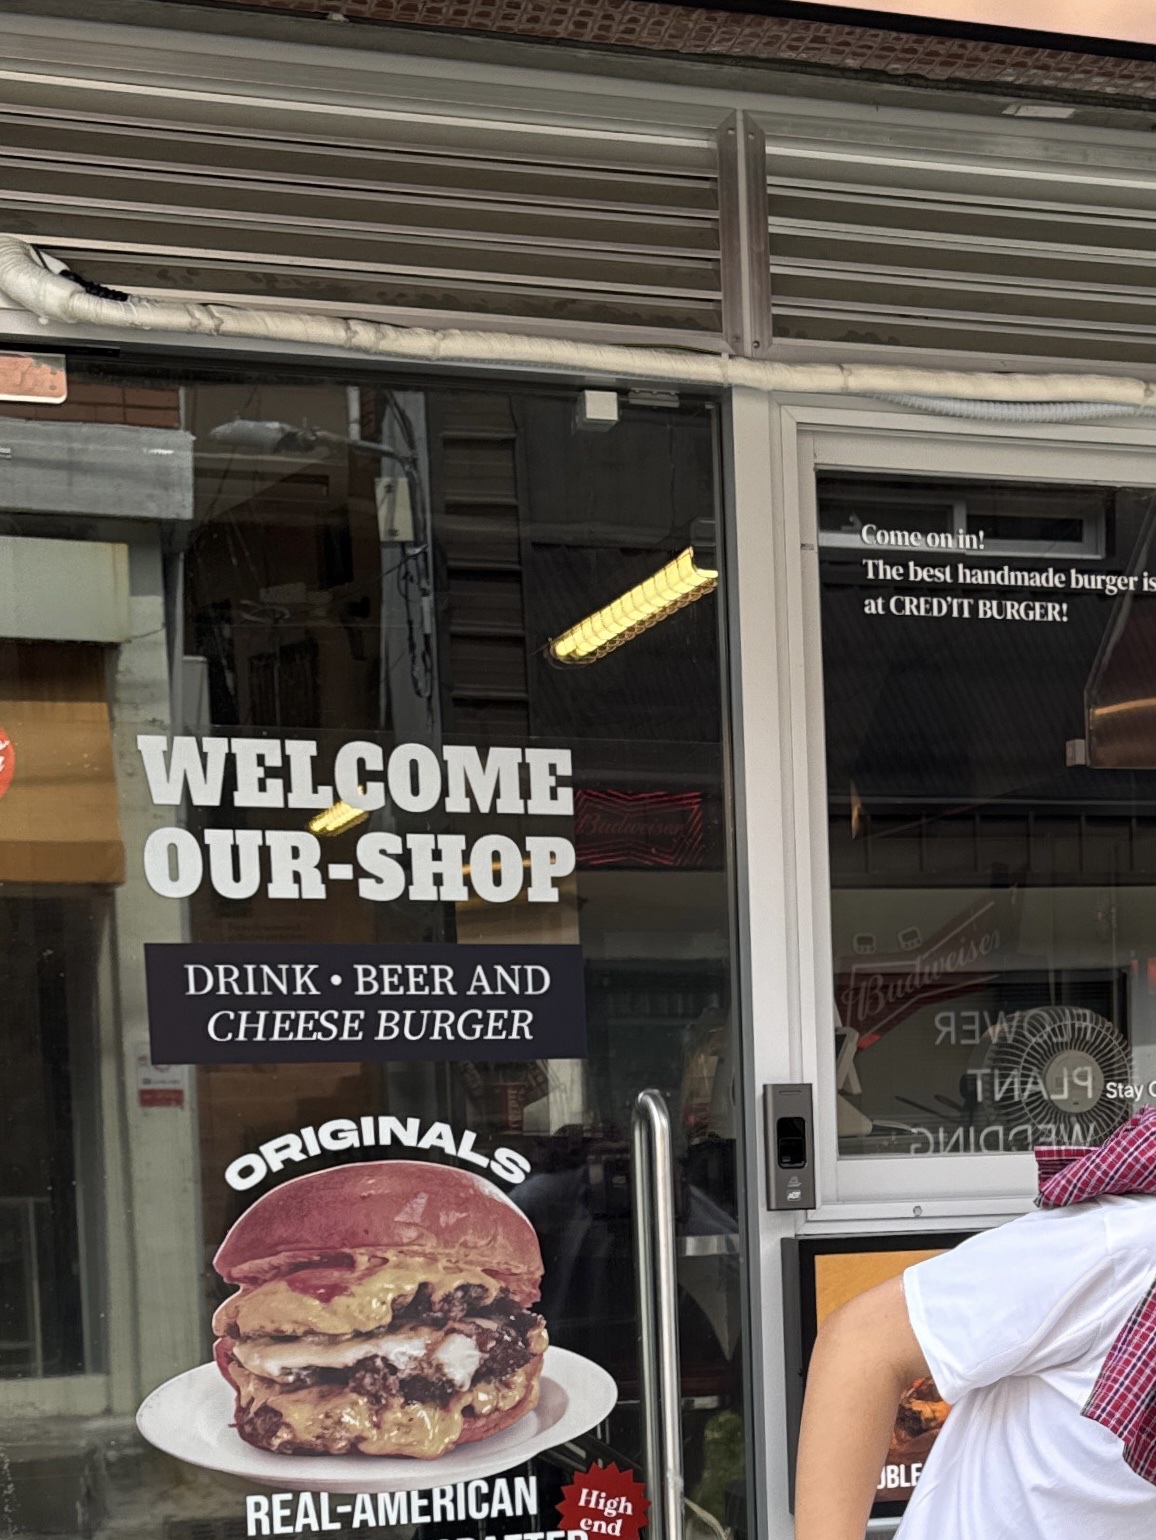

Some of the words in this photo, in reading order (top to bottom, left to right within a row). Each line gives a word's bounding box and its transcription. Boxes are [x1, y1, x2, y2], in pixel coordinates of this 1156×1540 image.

[861, 523, 922, 549] Come
[926, 532, 953, 551] on
[957, 529, 985, 551] in!
[862, 559, 904, 581] The
[908, 560, 953, 583] best
[957, 562, 1066, 588] handmade
[1070, 568, 1139, 596] burger
[863, 596, 885, 615] at
[889, 595, 974, 619] CRED'IT
[978, 599, 1068, 623] BURGER!
[136, 734, 574, 816] WELCOME
[143, 826, 576, 903] OUR-SHOP
[184, 964, 321, 996] DRINK
[353, 964, 458, 996] BEER
[466, 964, 551, 996] AND
[207, 1009, 365, 1042] CHEESE
[374, 1008, 534, 1041] BURGER
[1105, 1080, 1144, 1102] Stay
[224, 1115, 532, 1192] ORIGINALS
[245, 1476, 538, 1537] REAL-AMERICAN
[578, 1488, 633, 1518] High
[579, 1516, 623, 1538] end
